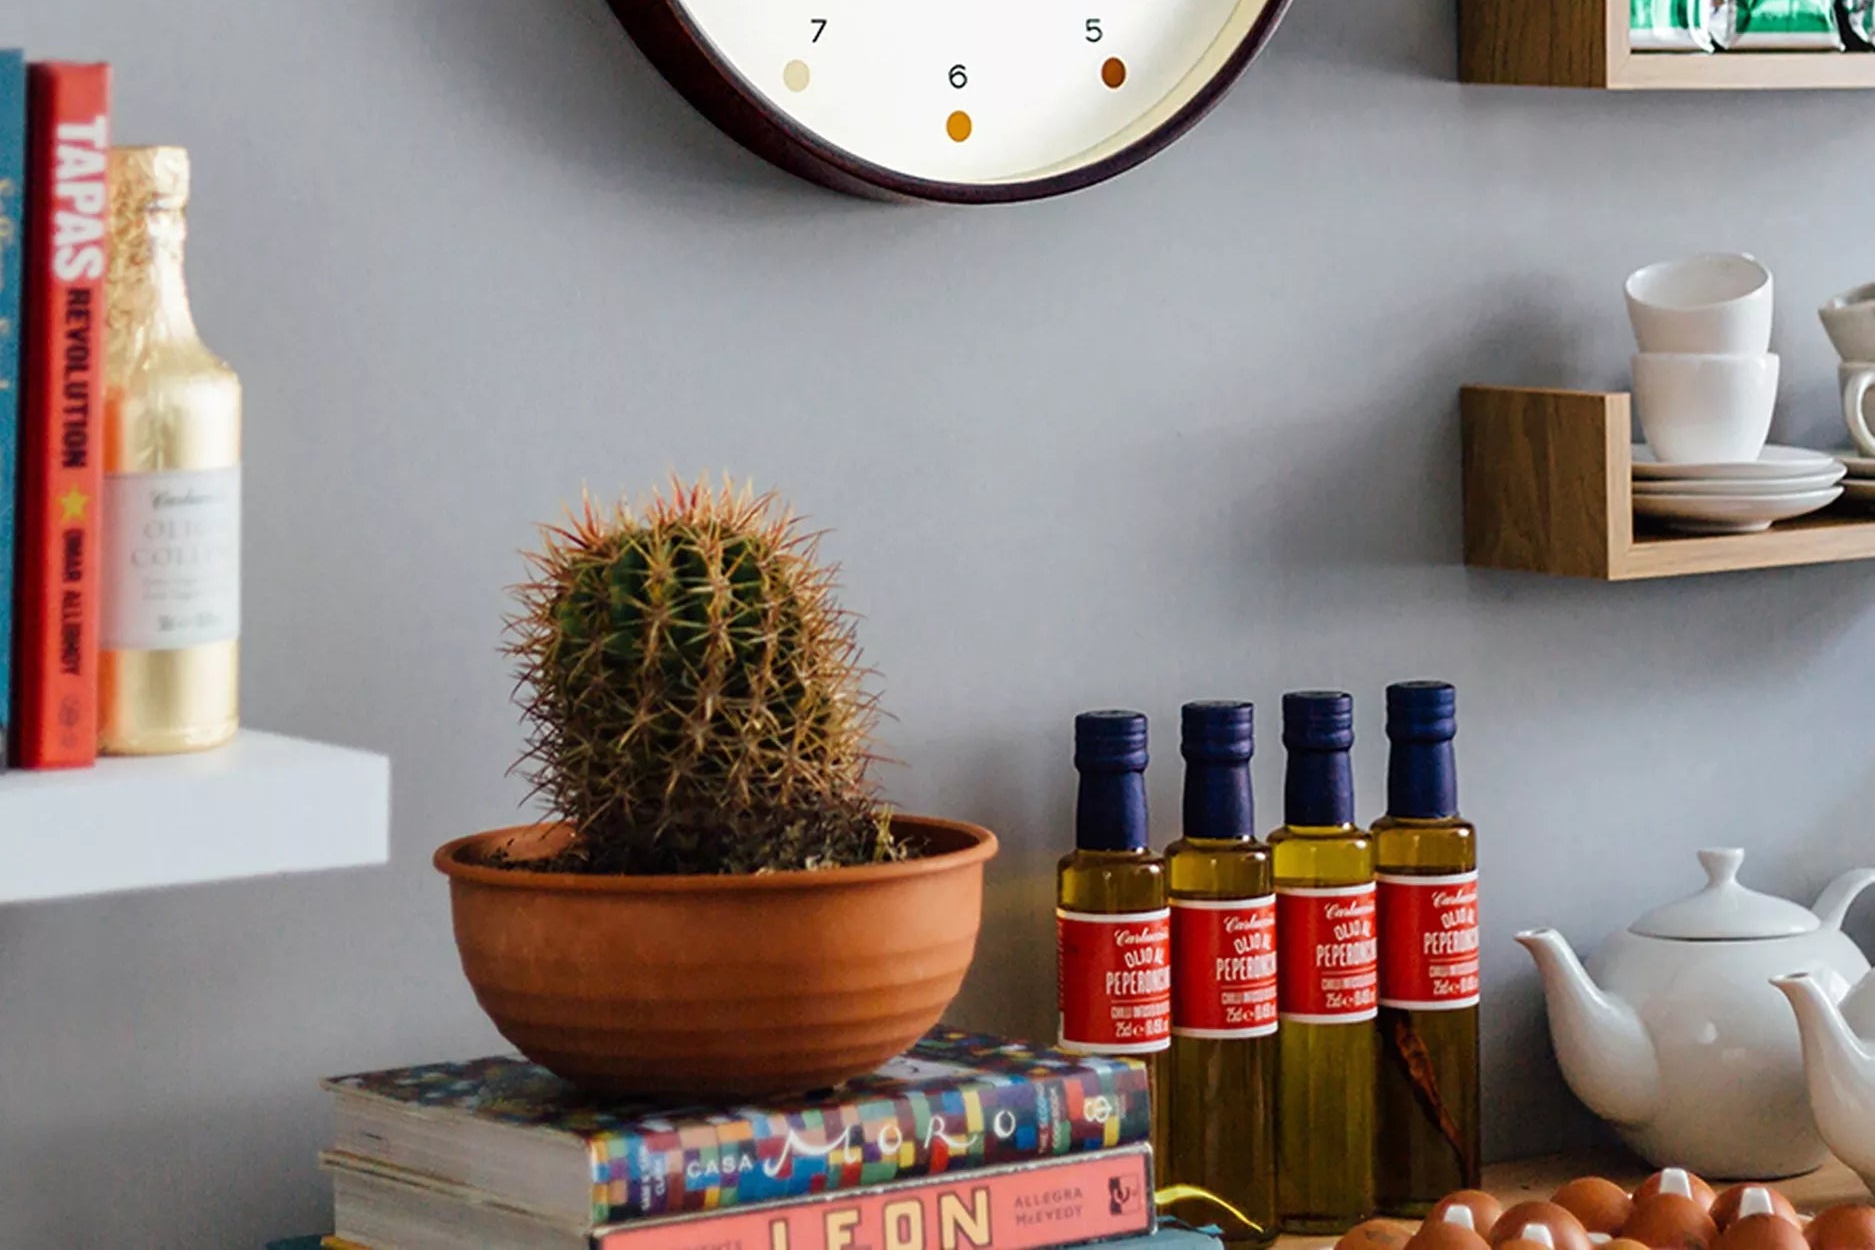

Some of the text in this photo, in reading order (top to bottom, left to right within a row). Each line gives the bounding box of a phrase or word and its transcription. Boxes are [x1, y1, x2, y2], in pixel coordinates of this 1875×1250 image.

[810, 18, 828, 44] 7
[1085, 18, 1104, 44] 5
[947, 63, 968, 90] 6
[53, 114, 106, 470] TAPAS REVOLUTION
[1316, 938, 1376, 967] PEPERON
[1423, 926, 1478, 955] PEPERON
[1105, 965, 1169, 995] PEPERON
[1216, 951, 1276, 981] PEPERON
[686, 1154, 753, 1178] CASA
[1014, 1187, 1083, 1209] ALLEGRA
